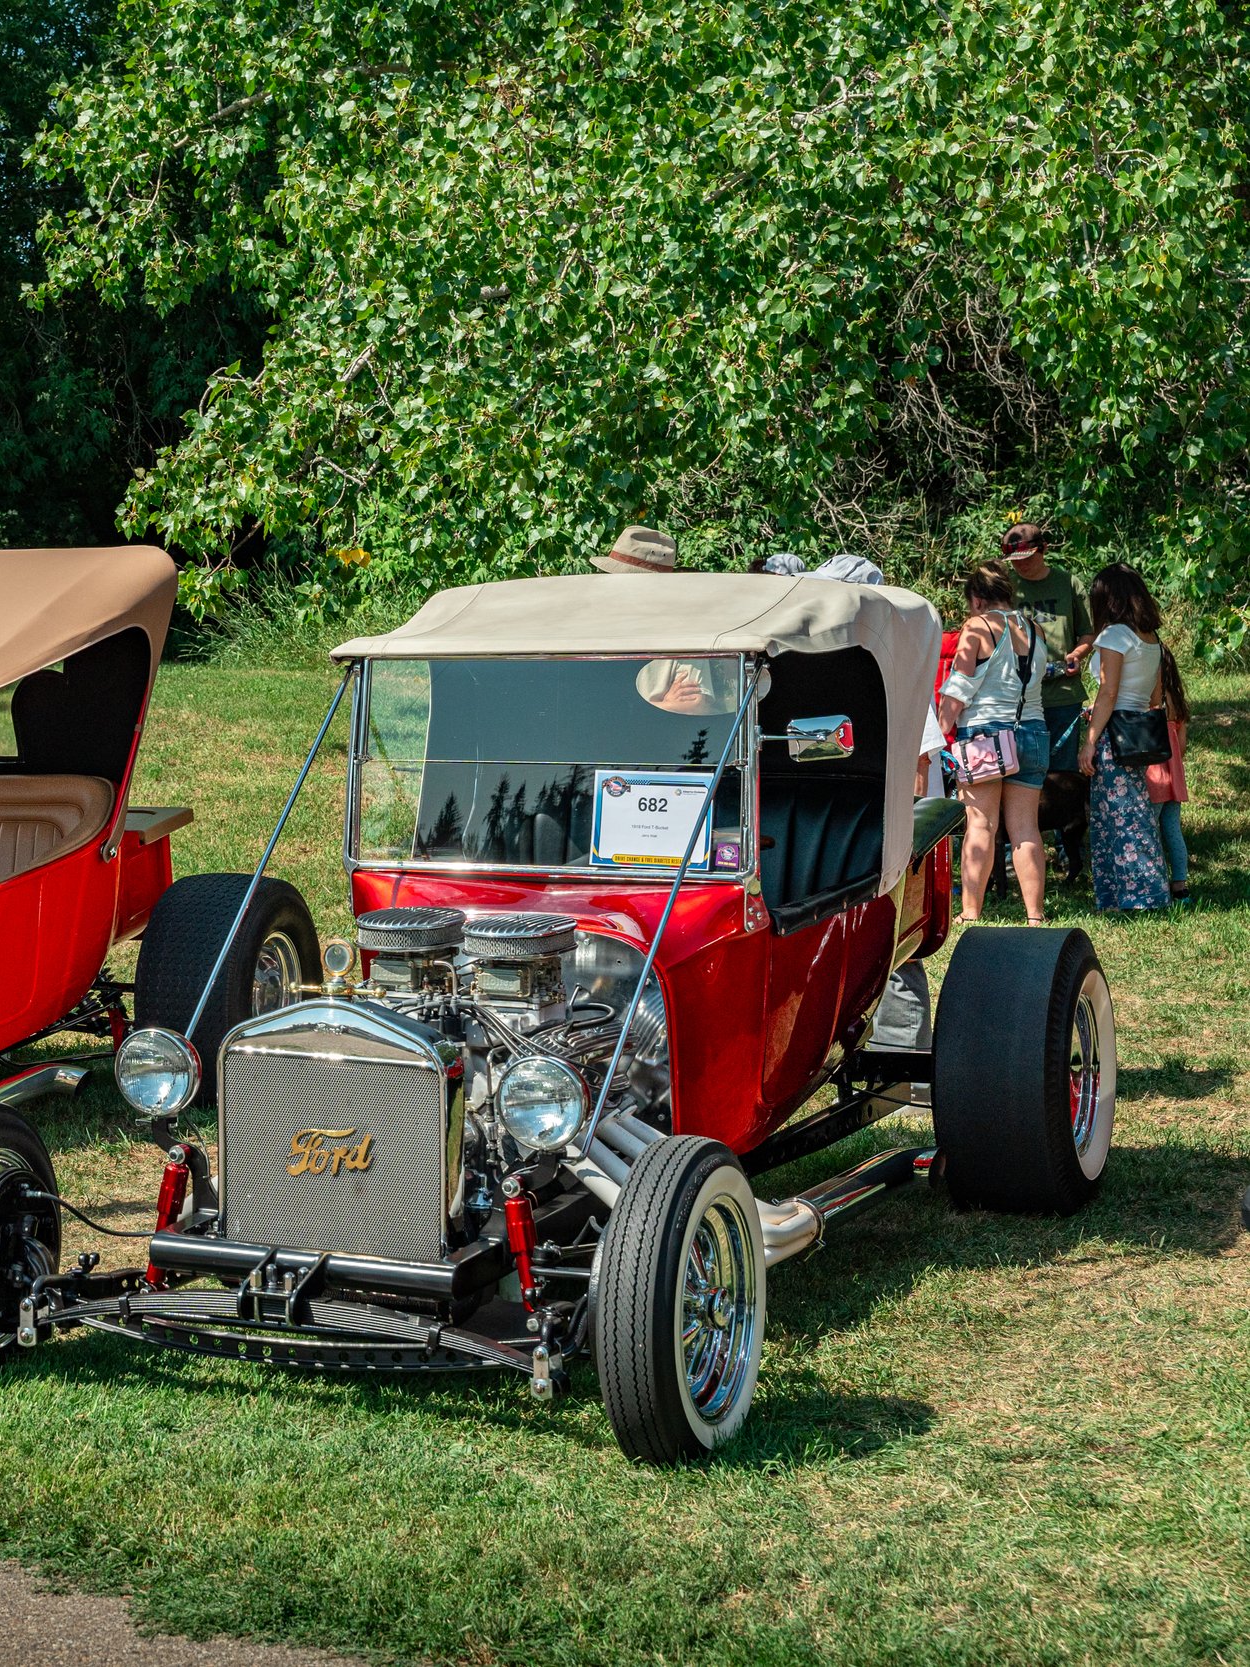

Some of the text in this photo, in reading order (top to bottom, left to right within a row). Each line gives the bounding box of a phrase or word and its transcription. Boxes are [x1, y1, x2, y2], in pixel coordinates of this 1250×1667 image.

[1018, 599, 1058, 620] CAT
[638, 797, 668, 812] 682
[285, 1127, 373, 1177] Ford
